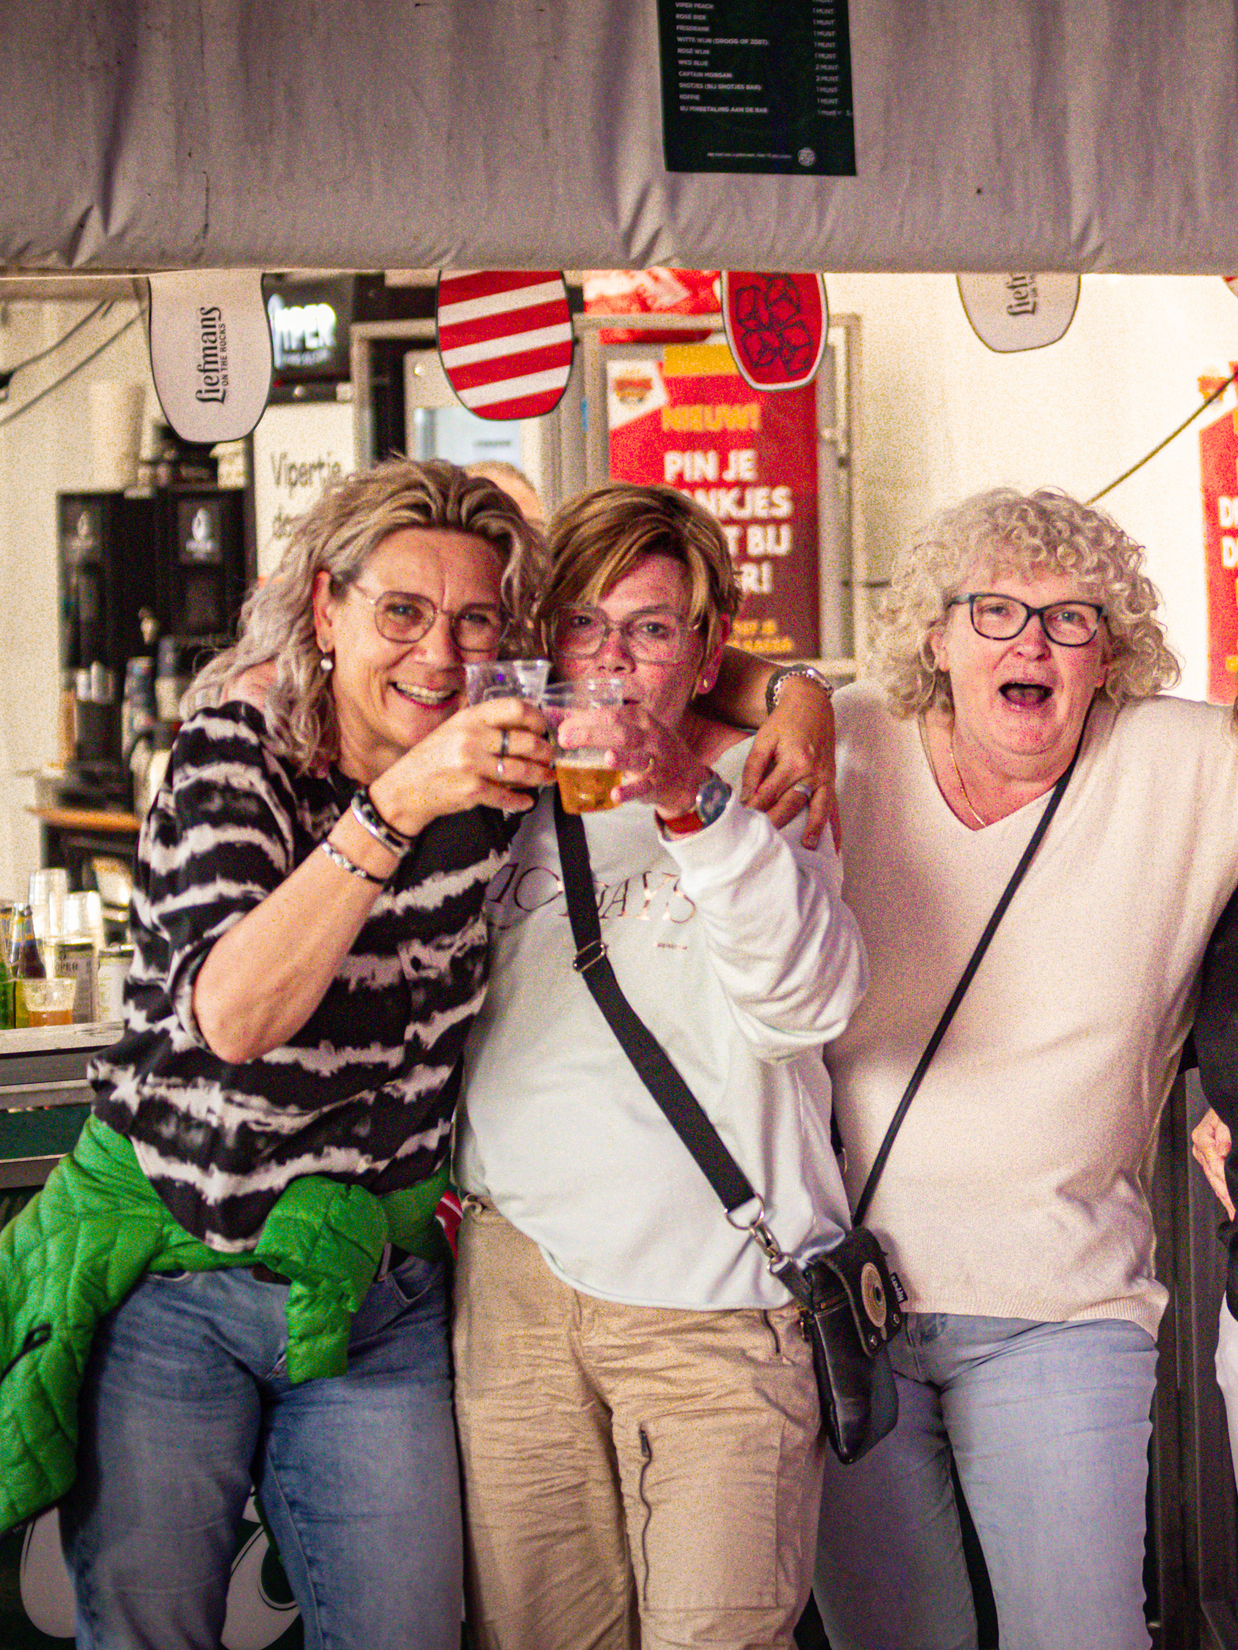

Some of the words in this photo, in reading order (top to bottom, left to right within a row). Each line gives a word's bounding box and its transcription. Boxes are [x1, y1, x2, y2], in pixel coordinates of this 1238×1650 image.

[218, 323, 227, 353] ROCKS
[195, 306, 226, 405] Liefmans
[219, 355, 228, 371] THE
[221, 374, 229, 387] ON
[661, 402, 761, 433] NIEUW!
[663, 450, 720, 484] PIN
[722, 450, 758, 483] JE
[746, 523, 792, 557] BIJ
